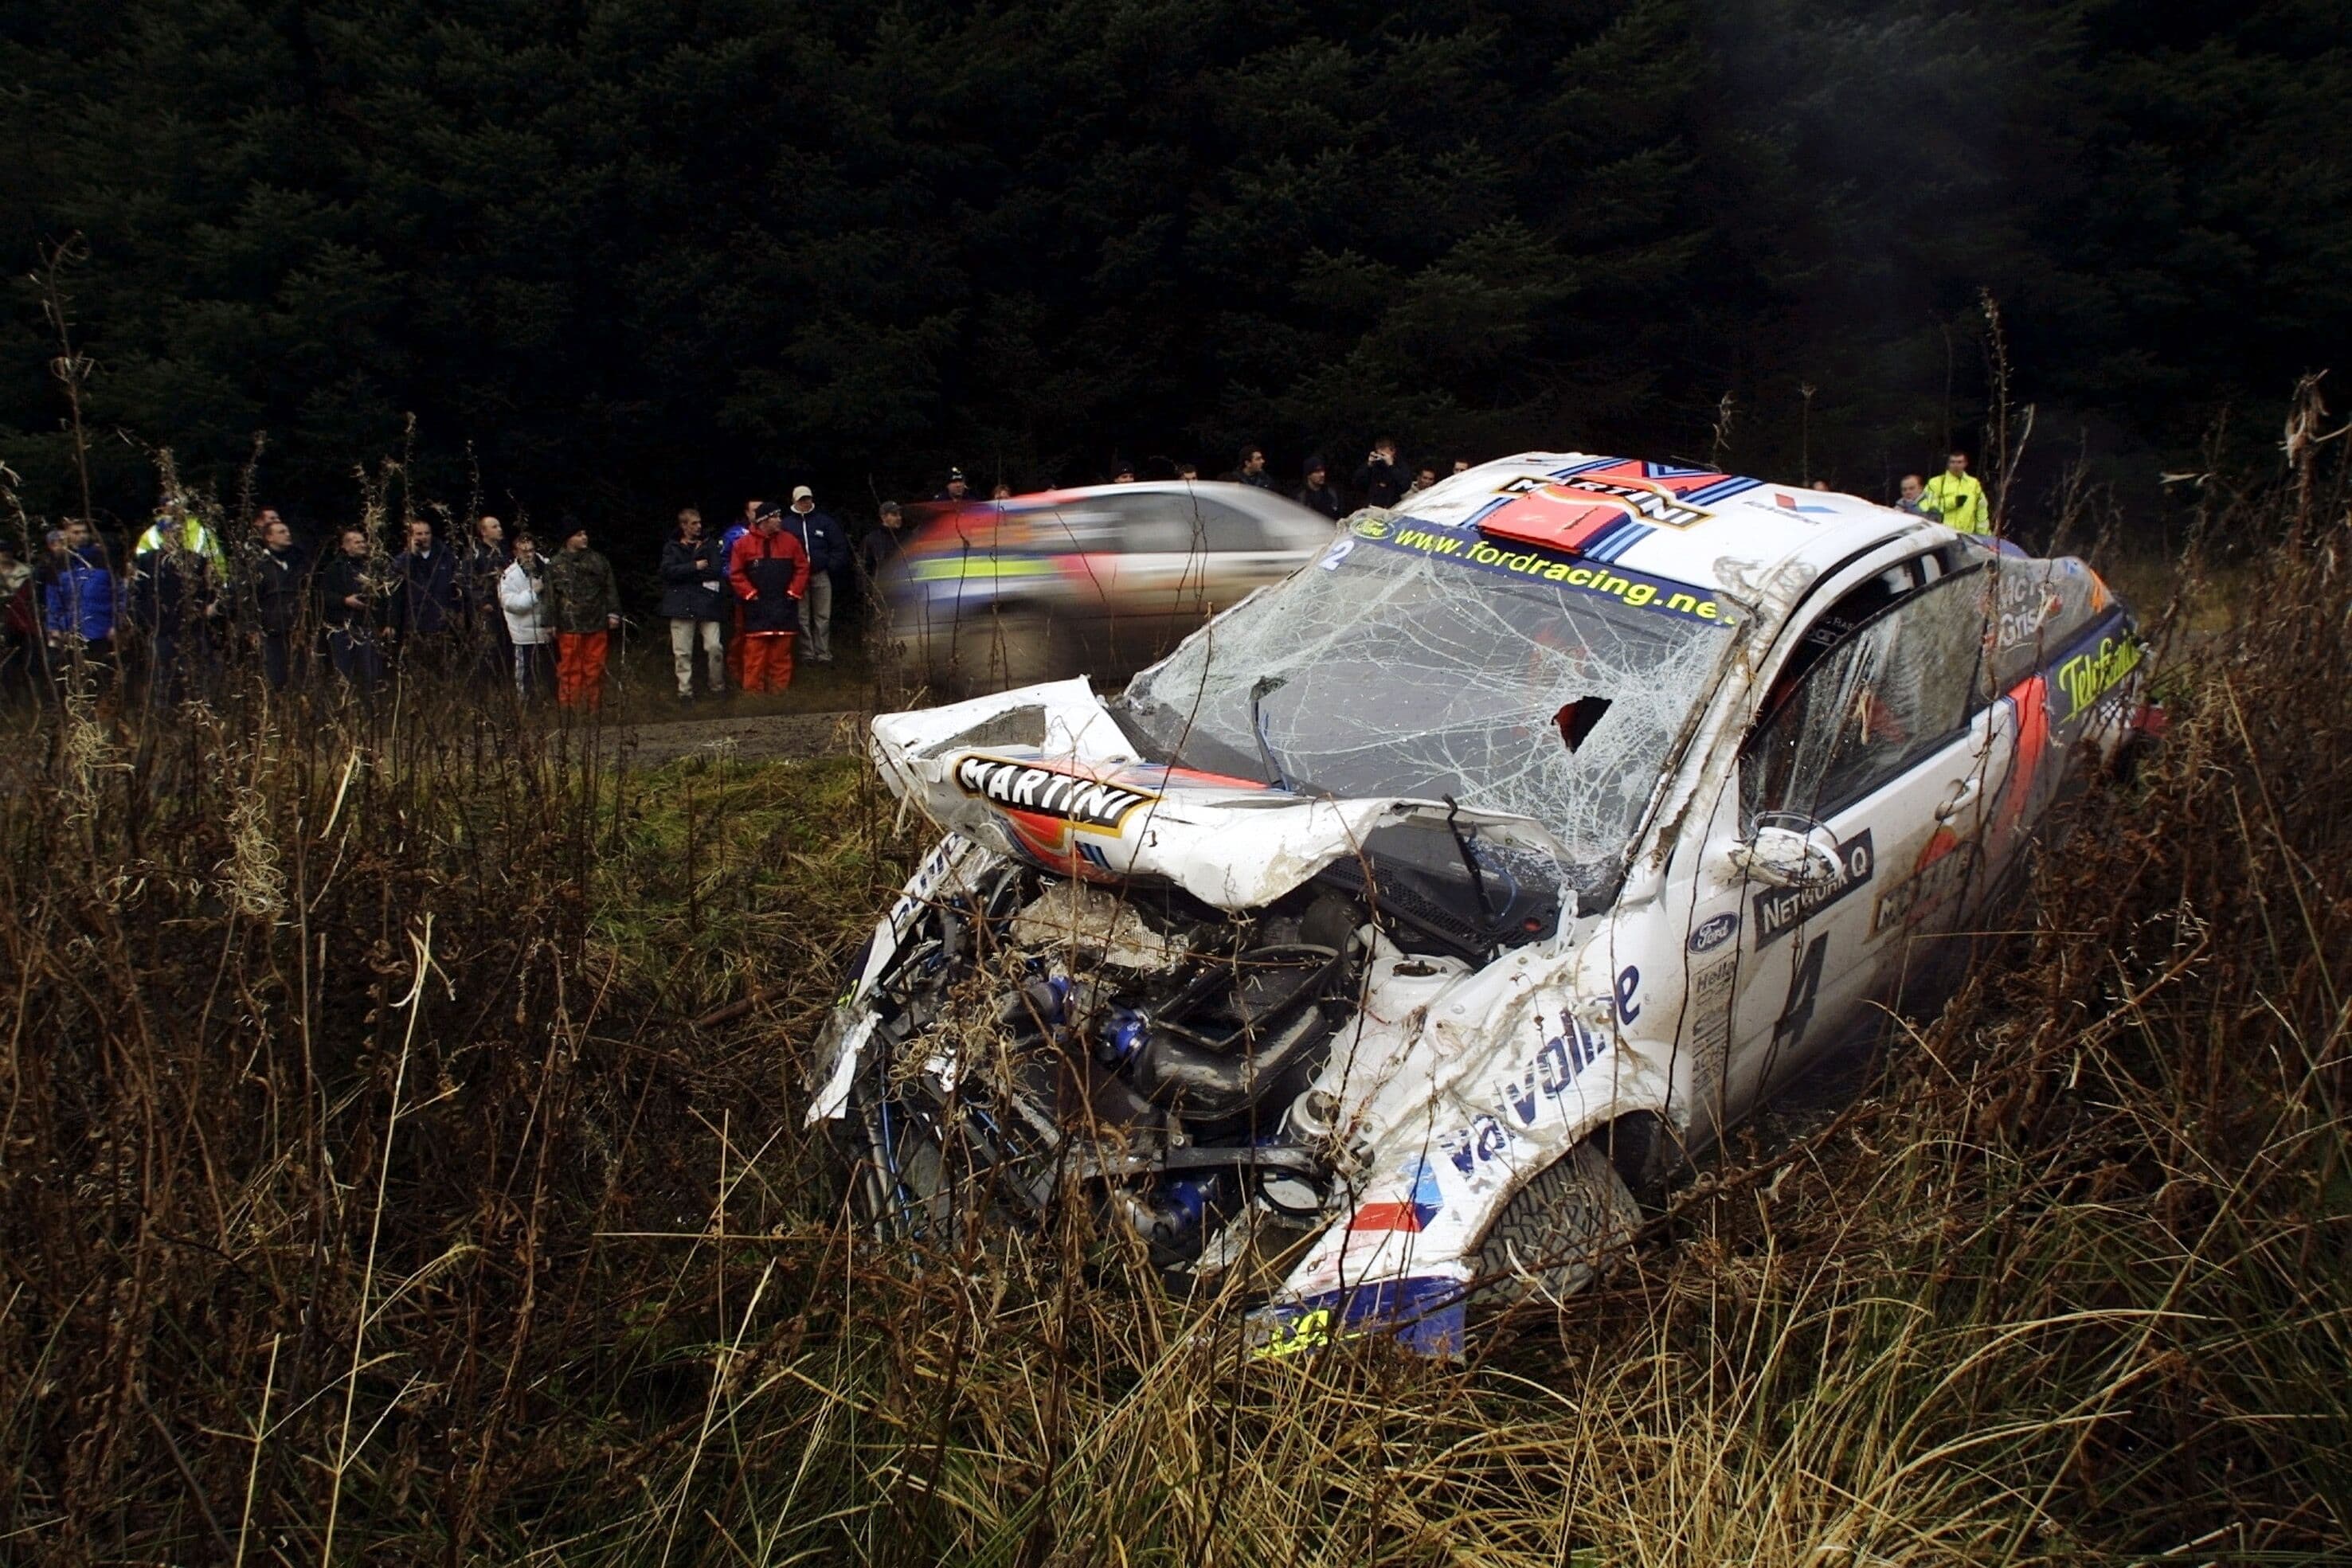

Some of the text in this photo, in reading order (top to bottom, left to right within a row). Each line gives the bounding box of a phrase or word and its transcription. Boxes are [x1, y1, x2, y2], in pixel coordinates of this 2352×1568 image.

[1319, 540, 1355, 570] 2
[961, 758, 1143, 820] MARTINI
[1850, 845, 1868, 877] Q
[1696, 917, 1730, 948] Ford
